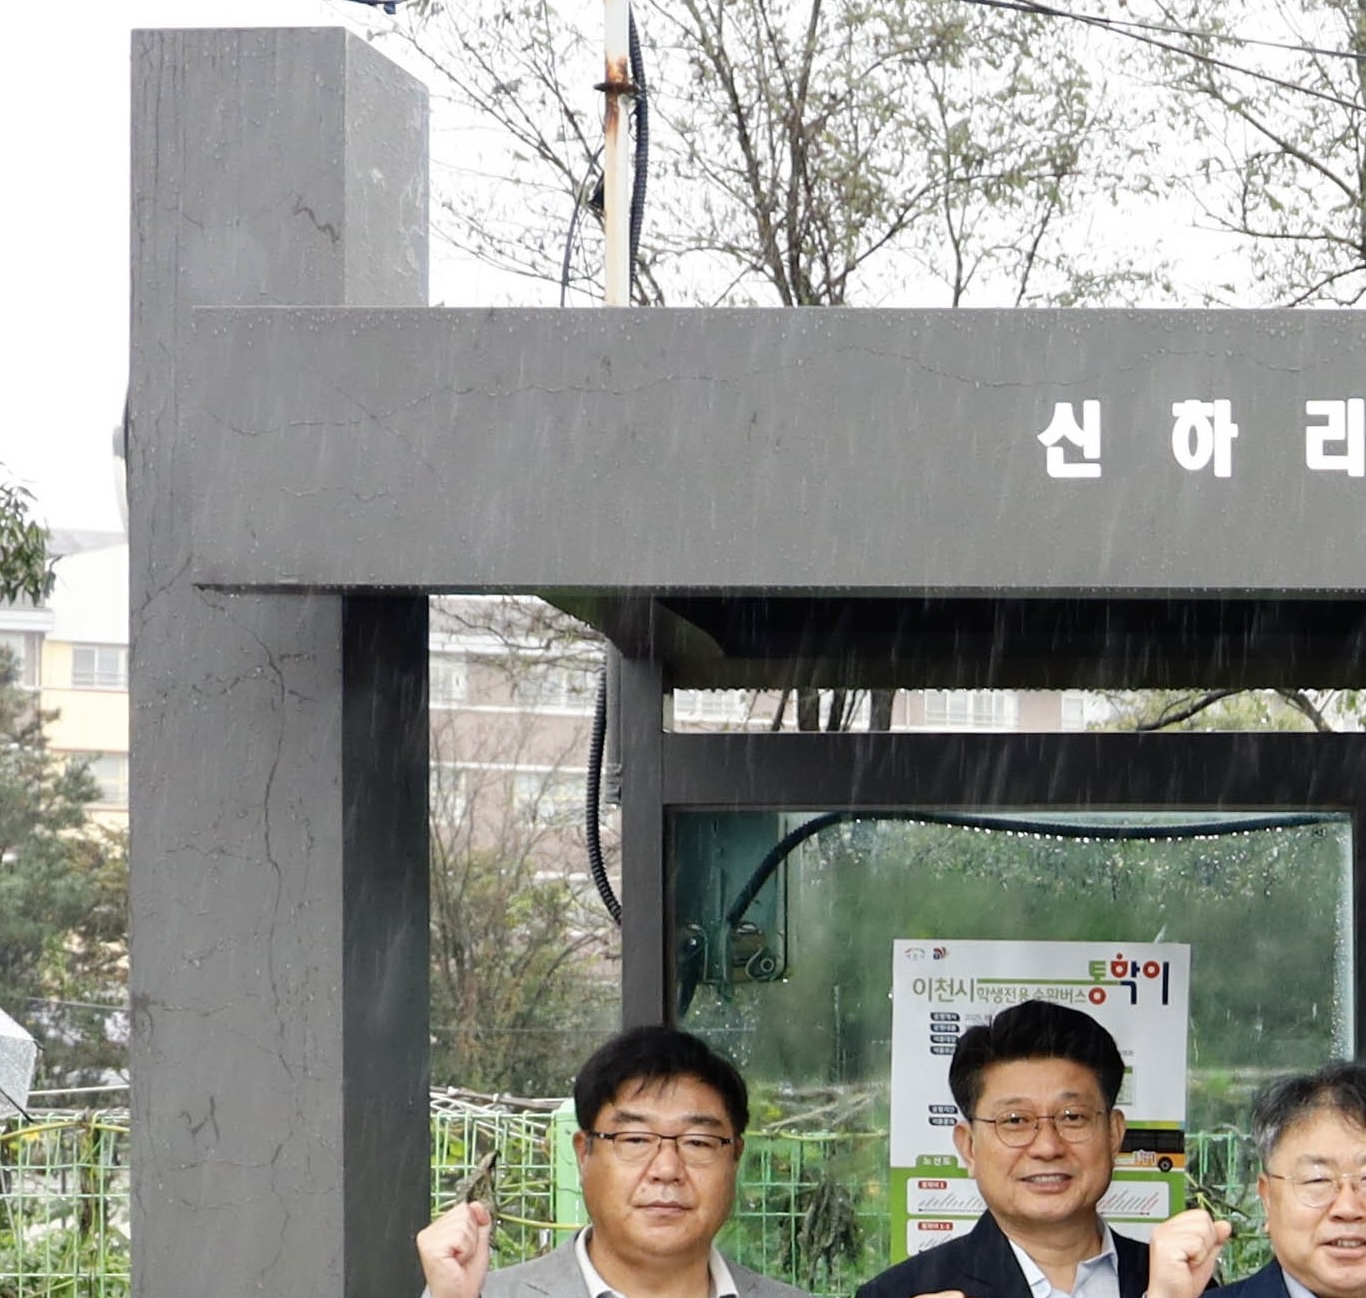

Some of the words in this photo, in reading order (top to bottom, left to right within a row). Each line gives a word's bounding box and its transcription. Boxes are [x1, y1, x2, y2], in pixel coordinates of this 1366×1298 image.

[912, 977, 975, 1003] 이천시
[977, 987, 1032, 1004] 학생전용
[1088, 953, 1169, 1006] 통학이
